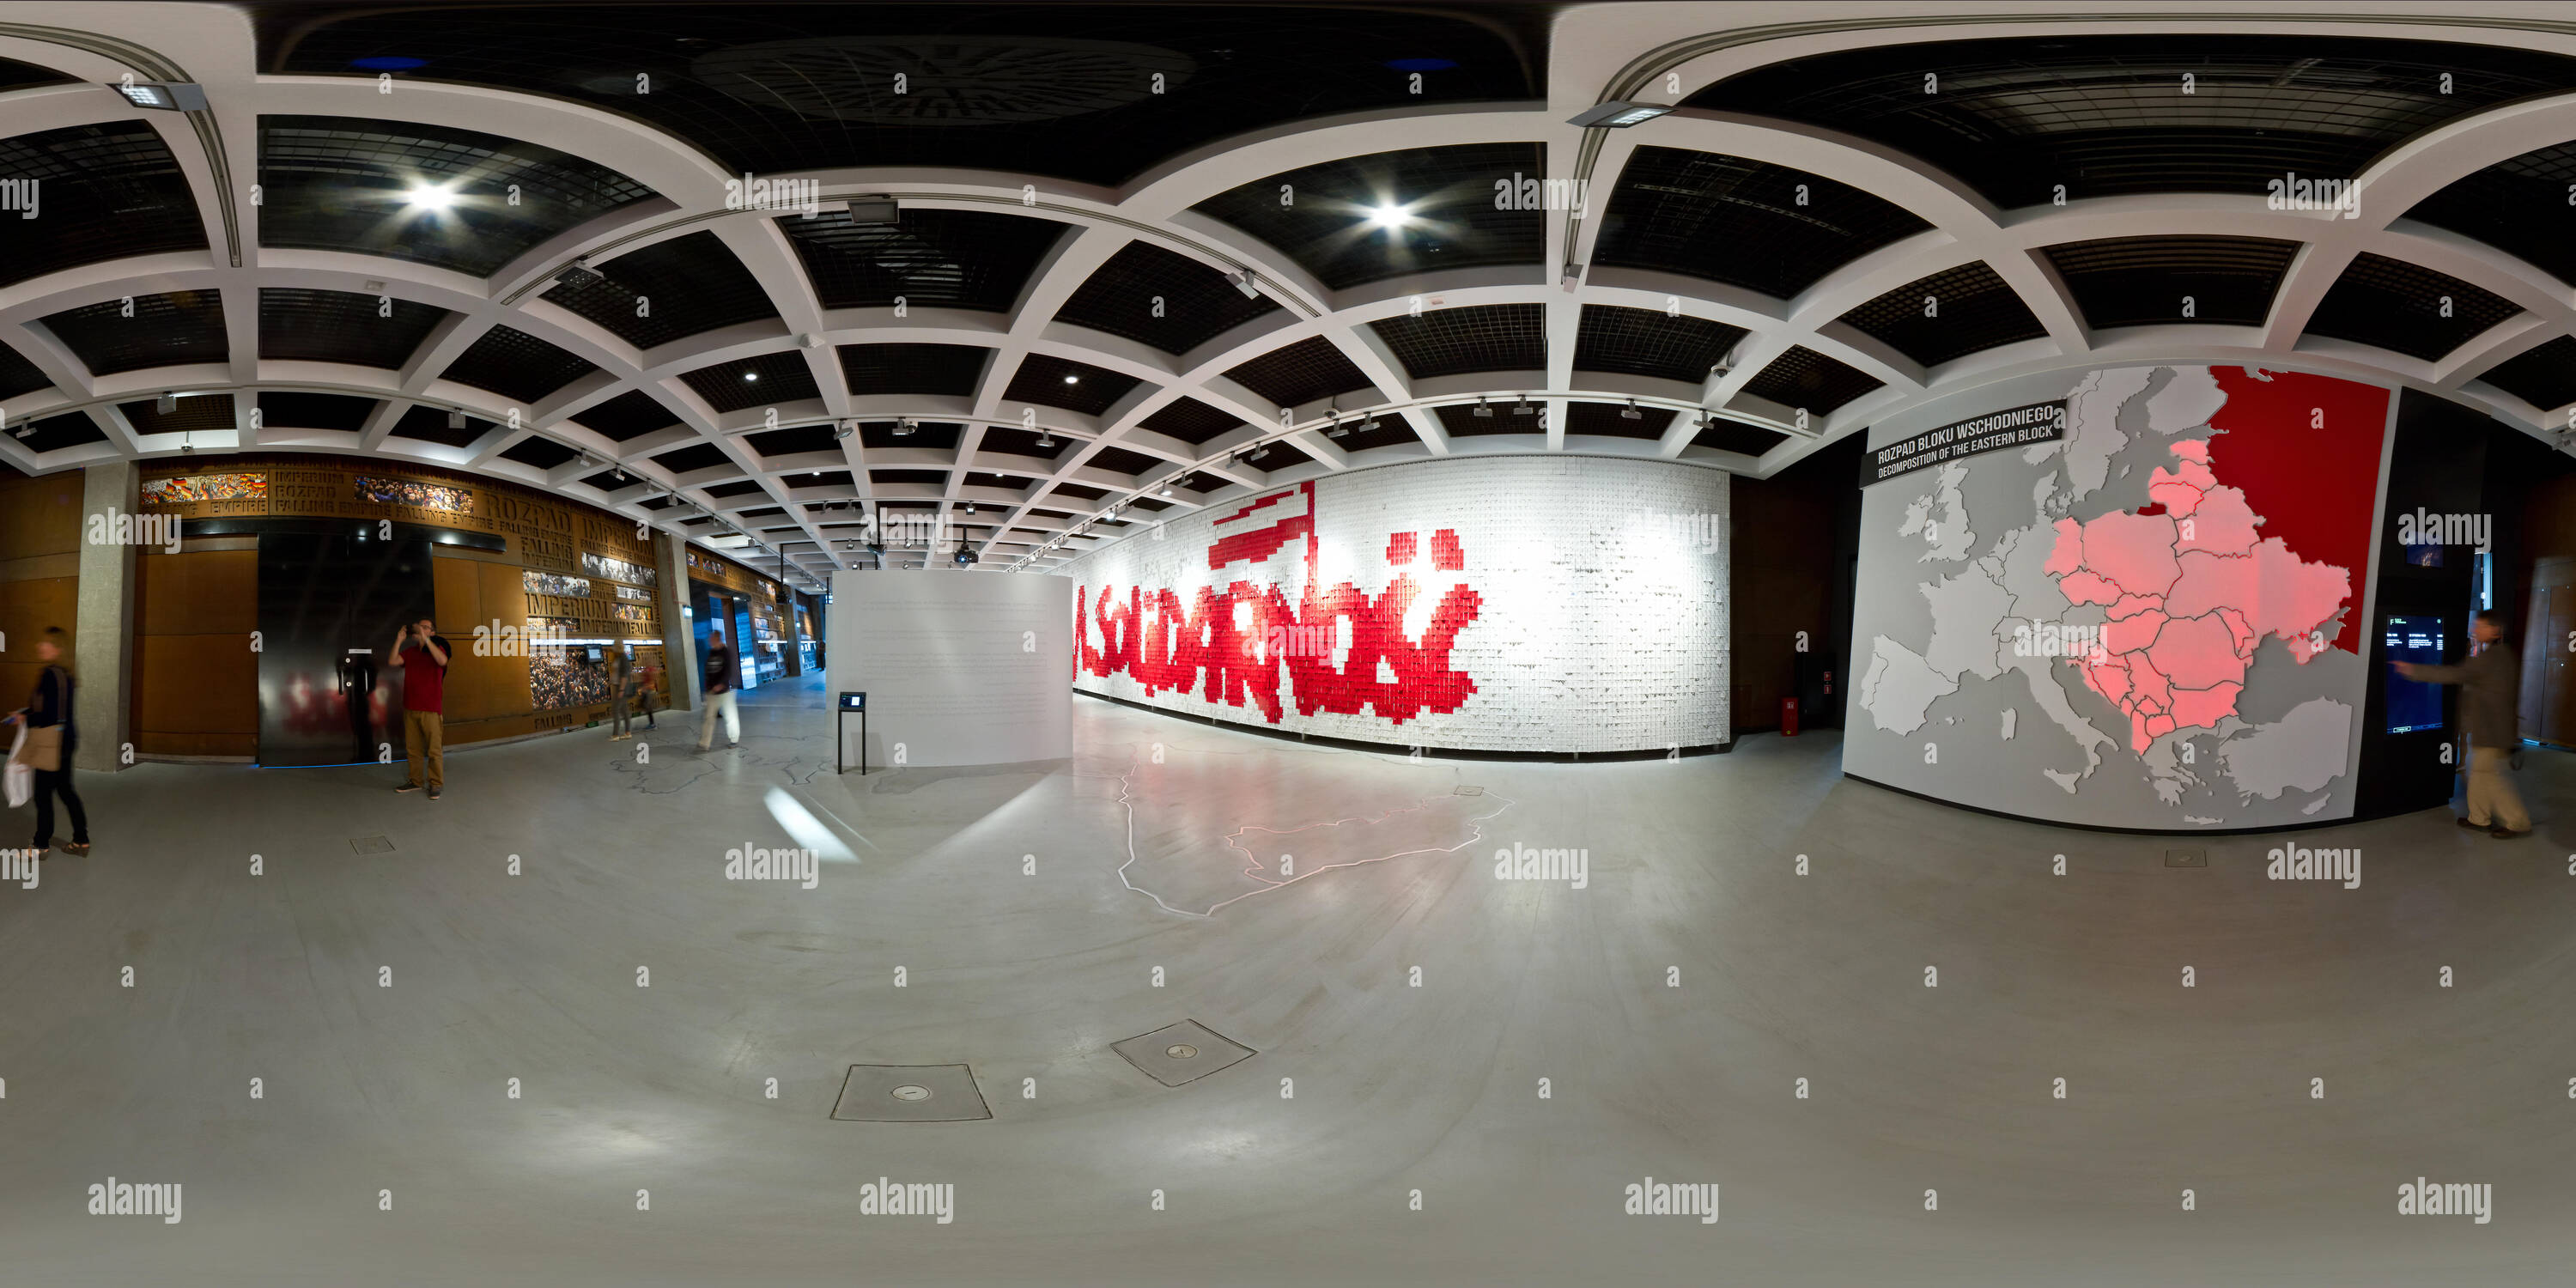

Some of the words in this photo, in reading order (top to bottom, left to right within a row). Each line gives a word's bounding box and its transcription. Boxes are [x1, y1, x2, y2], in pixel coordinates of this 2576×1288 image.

[1878, 440, 1916, 465] ROZPAD
[1917, 428, 1954, 452] BLOKU
[1957, 404, 2054, 440] WSCHODNIEGO
[1878, 451, 1937, 478] DECOMPOSITION
[1939, 448, 1950, 460] OF
[1952, 443, 1969, 457] THE
[1971, 432, 2015, 451] EASTERN
[2018, 424, 2053, 441] BLOCK
[275, 471, 344, 484] IMPERIUM
[275, 485, 337, 498] ROZPAD
[210, 500, 266, 513] EMPIRE
[275, 500, 335, 513] FALLING
[338, 501, 392, 517] EMPIRE
[396, 506, 447, 523] FALLING
[450, 513, 494, 530] EMPIRE
[484, 492, 571, 533] ROZPAD
[582, 517, 656, 556] IMPERIUM
[520, 537, 574, 561] FALLING
[521, 552, 574, 572] IMPERIUM
[525, 592, 610, 619] IMPERIUM
[581, 617, 630, 635] IMPERIUM
[631, 622, 662, 635] FALLING
[534, 713, 573, 731] FALLING
